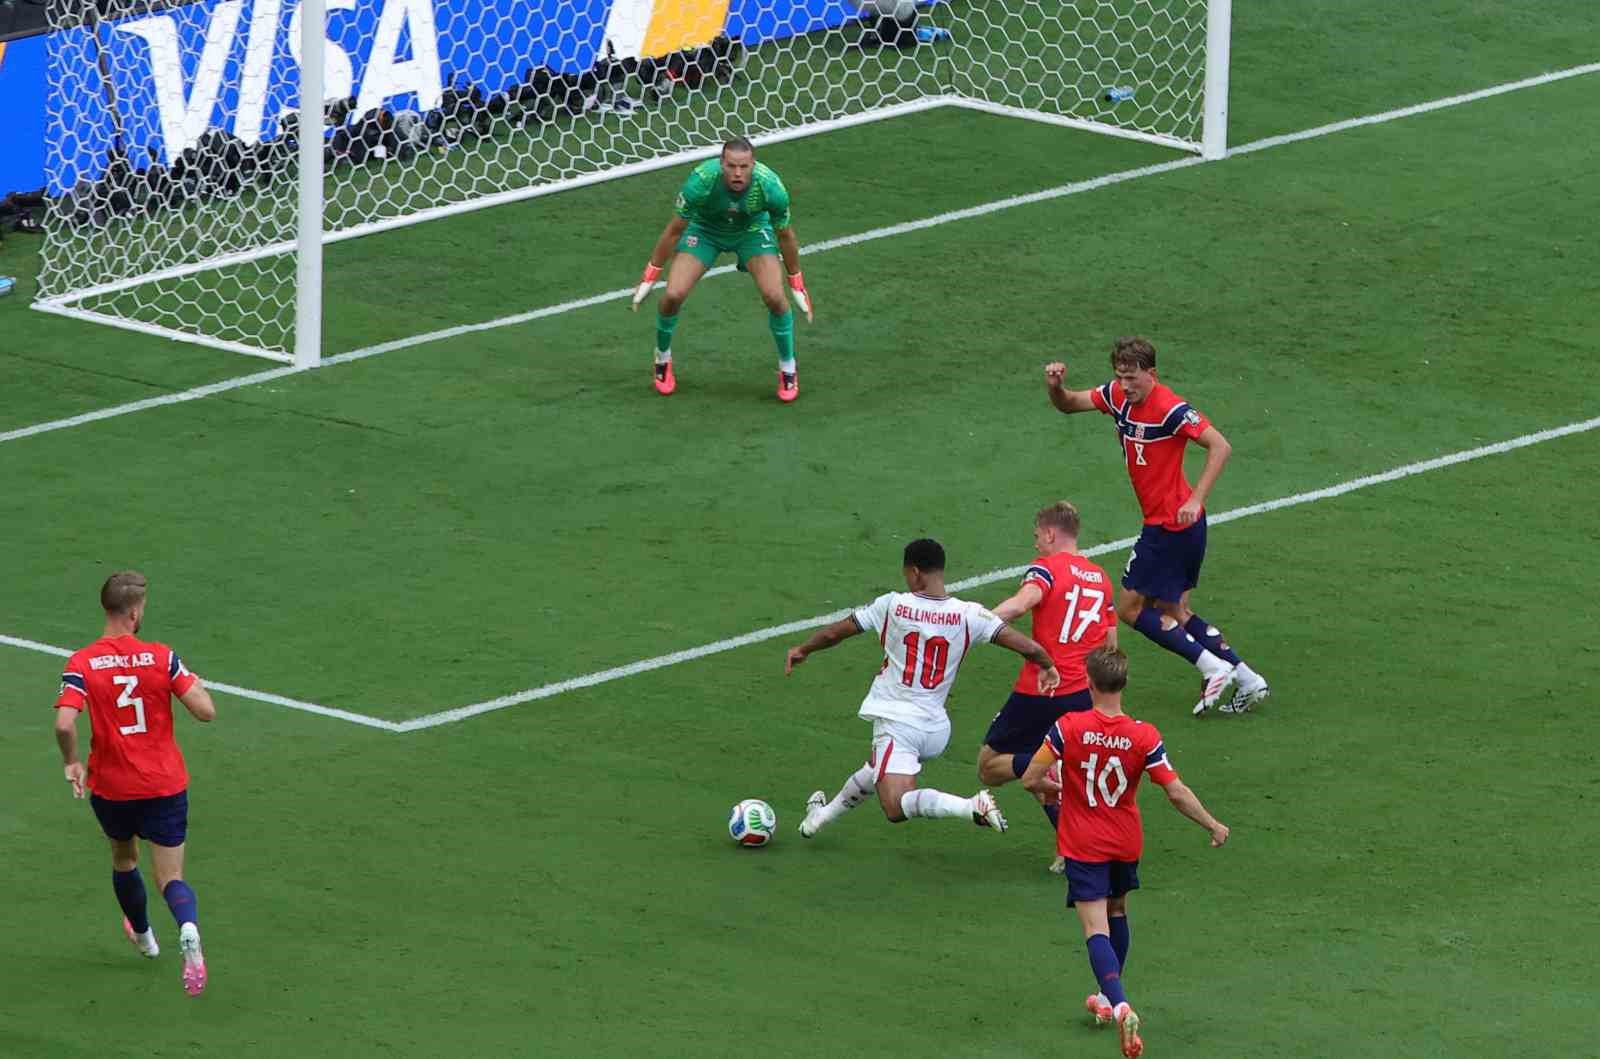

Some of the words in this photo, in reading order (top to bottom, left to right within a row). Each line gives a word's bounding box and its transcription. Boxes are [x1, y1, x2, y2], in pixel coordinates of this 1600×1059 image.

[1134, 442, 1148, 467] 8
[895, 603, 962, 626] BELLINGHAM
[1058, 583, 1105, 644] 17
[902, 631, 950, 689] 10
[112, 675, 147, 736] 3
[1080, 752, 1128, 807] 10
